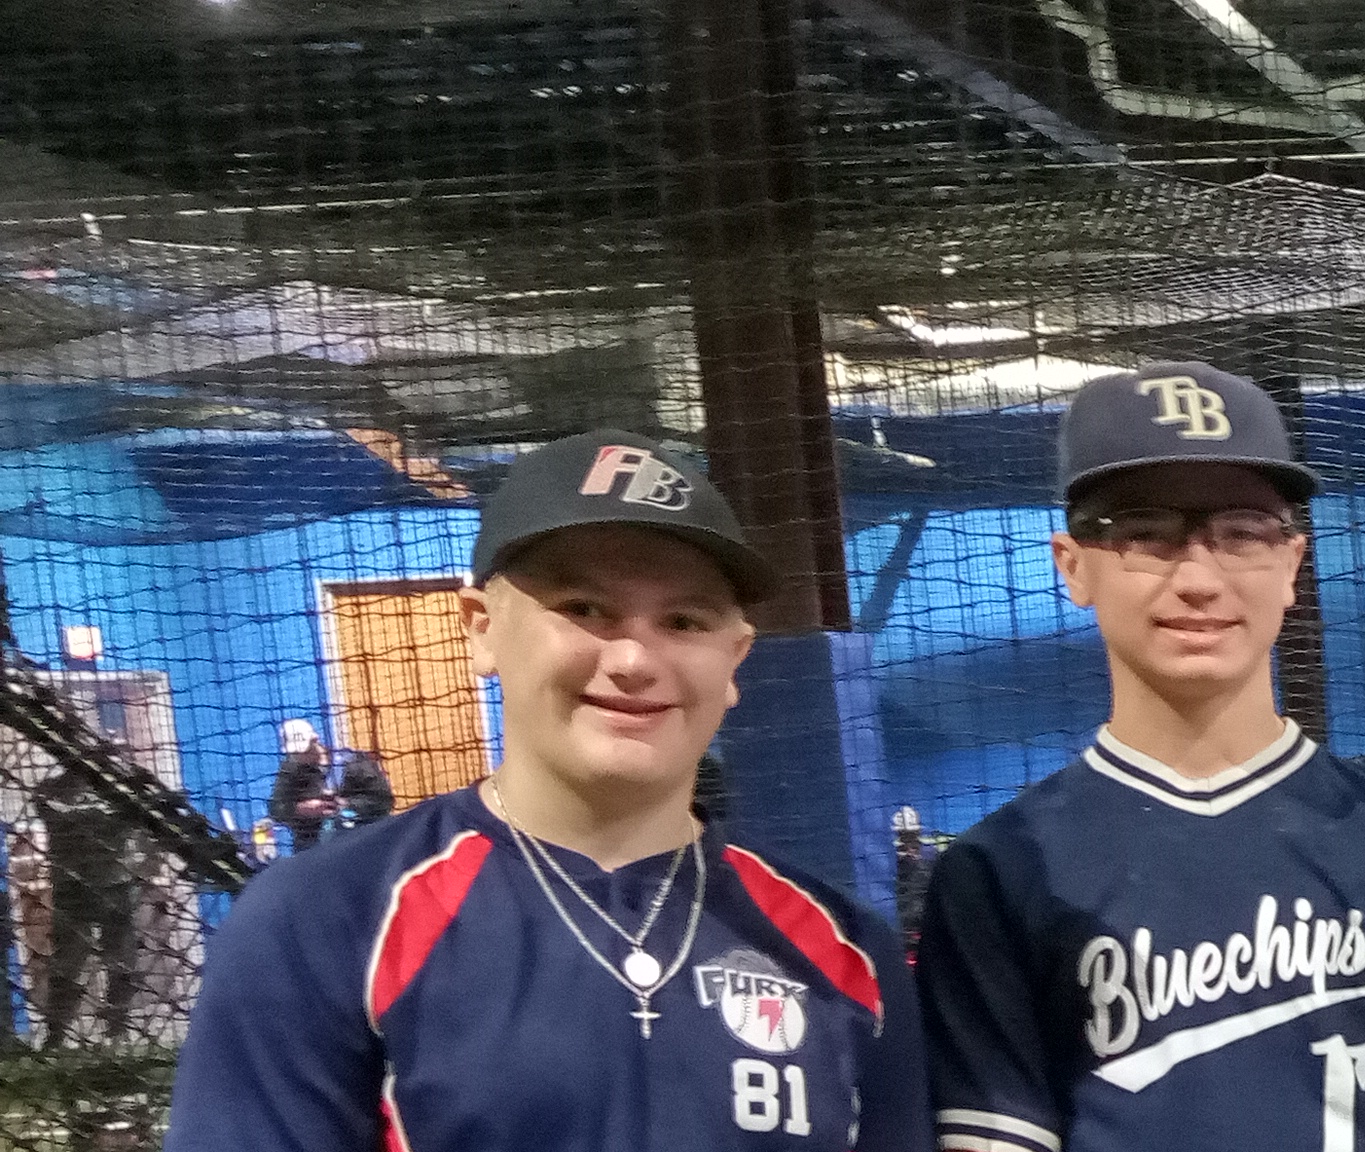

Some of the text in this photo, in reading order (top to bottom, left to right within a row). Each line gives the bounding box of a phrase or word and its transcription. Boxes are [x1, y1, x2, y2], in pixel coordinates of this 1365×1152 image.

[1136, 376, 1232, 440] TB
[693, 966, 809, 1008] FURY
[731, 1058, 811, 1137] 81
